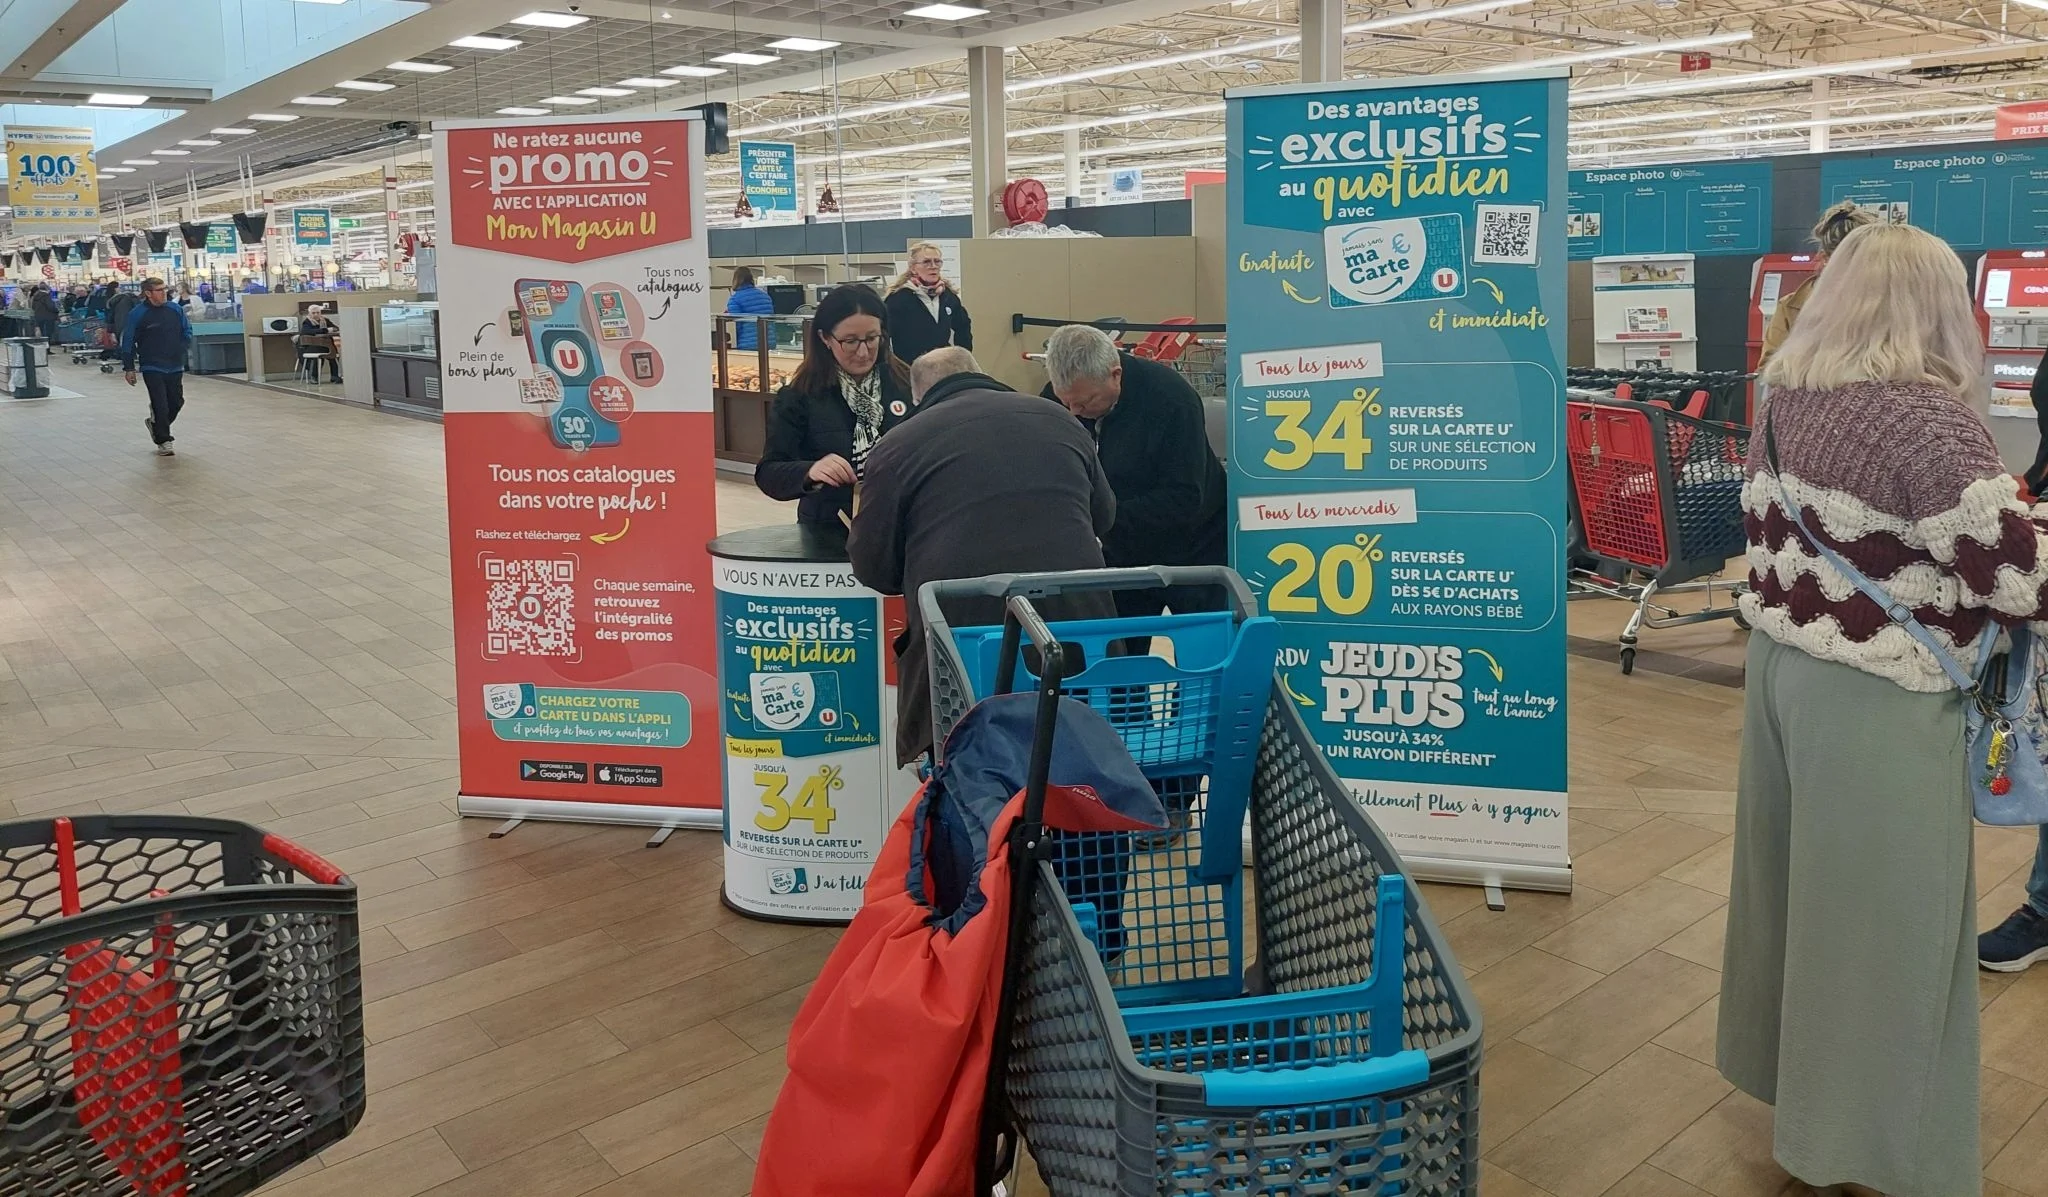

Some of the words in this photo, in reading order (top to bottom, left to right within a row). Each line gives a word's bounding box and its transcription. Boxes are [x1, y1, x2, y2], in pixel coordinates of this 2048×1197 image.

[1308, 101, 1350, 121] Des
[1355, 96, 1480, 118] avantages
[1280, 114, 1507, 163] exclusifs
[2012, 126, 2040, 135] PRIX
[493, 132, 518, 149] Ne
[522, 133, 570, 148] ratez
[574, 130, 642, 146] aucune
[748, 148, 787, 158] PRÉSENTER
[1893, 158, 1940, 171] Espace
[1943, 155, 1986, 169] photo
[490, 150, 649, 194] promo
[1586, 172, 1627, 184] Espace
[1630, 170, 1665, 182] photo
[746, 184, 788, 195] ÉCONOMIES
[1280, 181, 1306, 198] au
[1313, 151, 1508, 221] quotidien
[493, 196, 532, 210] AVEC
[536, 192, 646, 208] L'APPLICATION
[1338, 205, 1374, 218] avec
[486, 214, 538, 240] Mon
[542, 212, 634, 250] Magasin
[640, 212, 656, 236] U
[1367, 236, 1384, 247] sans
[1239, 250, 1315, 274] Gratuite
[1345, 248, 1380, 270] ma
[644, 266, 671, 278] Tous
[674, 267, 695, 278] nos
[1348, 256, 1410, 286] Carte
[637, 277, 704, 299] catalogues
[1429, 308, 1446, 332] et
[1452, 306, 1550, 332] immédiate
[460, 351, 489, 362] Plein
[492, 351, 504, 362] de
[448, 363, 480, 378] bons
[482, 364, 518, 382] plans
[1256, 359, 1294, 378] Tous
[1298, 356, 1323, 374] les
[1324, 354, 1369, 378] jours
[1994, 364, 2038, 376] Photo
[1266, 388, 1311, 400] JUSQU'À
[1389, 404, 1464, 418] REVERSÉS
[1263, 387, 1382, 472] 34%
[1389, 424, 1419, 436] SUR
[1422, 423, 1442, 436] LA
[1444, 423, 1494, 436] CARTE
[1389, 442, 1417, 454] SUR
[1422, 442, 1450, 454] UNE
[1454, 438, 1536, 454] SÉLECTION
[1390, 458, 1408, 470] DE
[1412, 458, 1488, 471] PRODUITS
[488, 464, 532, 482] Tous
[536, 468, 570, 483] nos
[573, 465, 676, 488] catalogues
[499, 491, 542, 509] dans
[546, 492, 594, 510] votre
[598, 486, 656, 520] poche
[1254, 504, 1294, 522] Tous
[1296, 502, 1320, 520] les
[1324, 500, 1400, 518] mercredis
[476, 530, 512, 540] Flashez
[513, 530, 524, 540] et
[524, 530, 581, 542] téléchargez
[1391, 550, 1465, 564] REVERSÉS
[723, 568, 758, 586] VOUS
[764, 572, 820, 588] N'AVEZ
[826, 574, 856, 588] PAS
[1267, 532, 1384, 615] 20%
[1391, 568, 1421, 581] SUR
[1424, 569, 1443, 582] LA
[1446, 570, 1496, 582] CARTE
[594, 579, 640, 594] Chaque
[642, 580, 696, 594] semaine,
[1391, 584, 1419, 598] DÈS
[1422, 586, 1440, 598] 5€
[1444, 586, 1520, 600] D'ACHATS
[594, 597, 660, 608] retrouvez
[748, 602, 768, 614] Des
[771, 604, 836, 618] avantages
[1391, 604, 1420, 616] AUX
[1424, 604, 1484, 617] RAYONS
[1488, 603, 1523, 618] BÉBÉ
[594, 612, 673, 627] l'intégralité
[736, 616, 854, 640] exclusifs
[596, 629, 618, 641] des
[621, 630, 673, 644] promos
[736, 645, 748, 655] au
[750, 635, 856, 672] quotidien
[1275, 648, 1310, 667] RDV
[1320, 641, 1464, 680] JEUDIS
[493, 700, 516, 710] Carte
[540, 695, 596, 708] CHARGEZ
[599, 696, 640, 710] VOTRE
[765, 699, 805, 716] Carte
[1321, 676, 1465, 729] PLUS
[1472, 687, 1500, 705] tout
[1502, 694, 1522, 705] au
[1524, 690, 1558, 712] long
[540, 710, 578, 722] CARTE
[582, 710, 590, 722] U
[593, 710, 625, 723] DANS
[628, 712, 672, 725] L'APPLI
[563, 724, 574, 736] de
[598, 728, 614, 738] vos
[834, 732, 876, 743] immédiate
[1343, 729, 1408, 744] JUSQU'À
[1412, 734, 1444, 746] 34%
[729, 742, 742, 754] Tous
[1327, 745, 1350, 758] UN
[1353, 747, 1405, 762] RAYON
[540, 769, 568, 780] Google
[568, 770, 584, 781] Play
[754, 764, 787, 774] JUSQU'À
[614, 774, 635, 784] l'App
[636, 775, 657, 784] Store
[754, 764, 844, 834] 34%
[1428, 793, 1468, 814] Plus
[1503, 805, 1560, 825] gagner
[740, 830, 781, 845] REVERSÉS
[782, 836, 800, 846] SUR
[803, 838, 814, 847] LA
[816, 839, 848, 848] CARTE
[736, 840, 748, 850] SUR
[749, 844, 764, 854] UNE
[765, 846, 810, 858] SÉLECTION
[812, 850, 824, 858] DE
[825, 851, 869, 859] PRODUITS
[840, 875, 867, 892] tell
